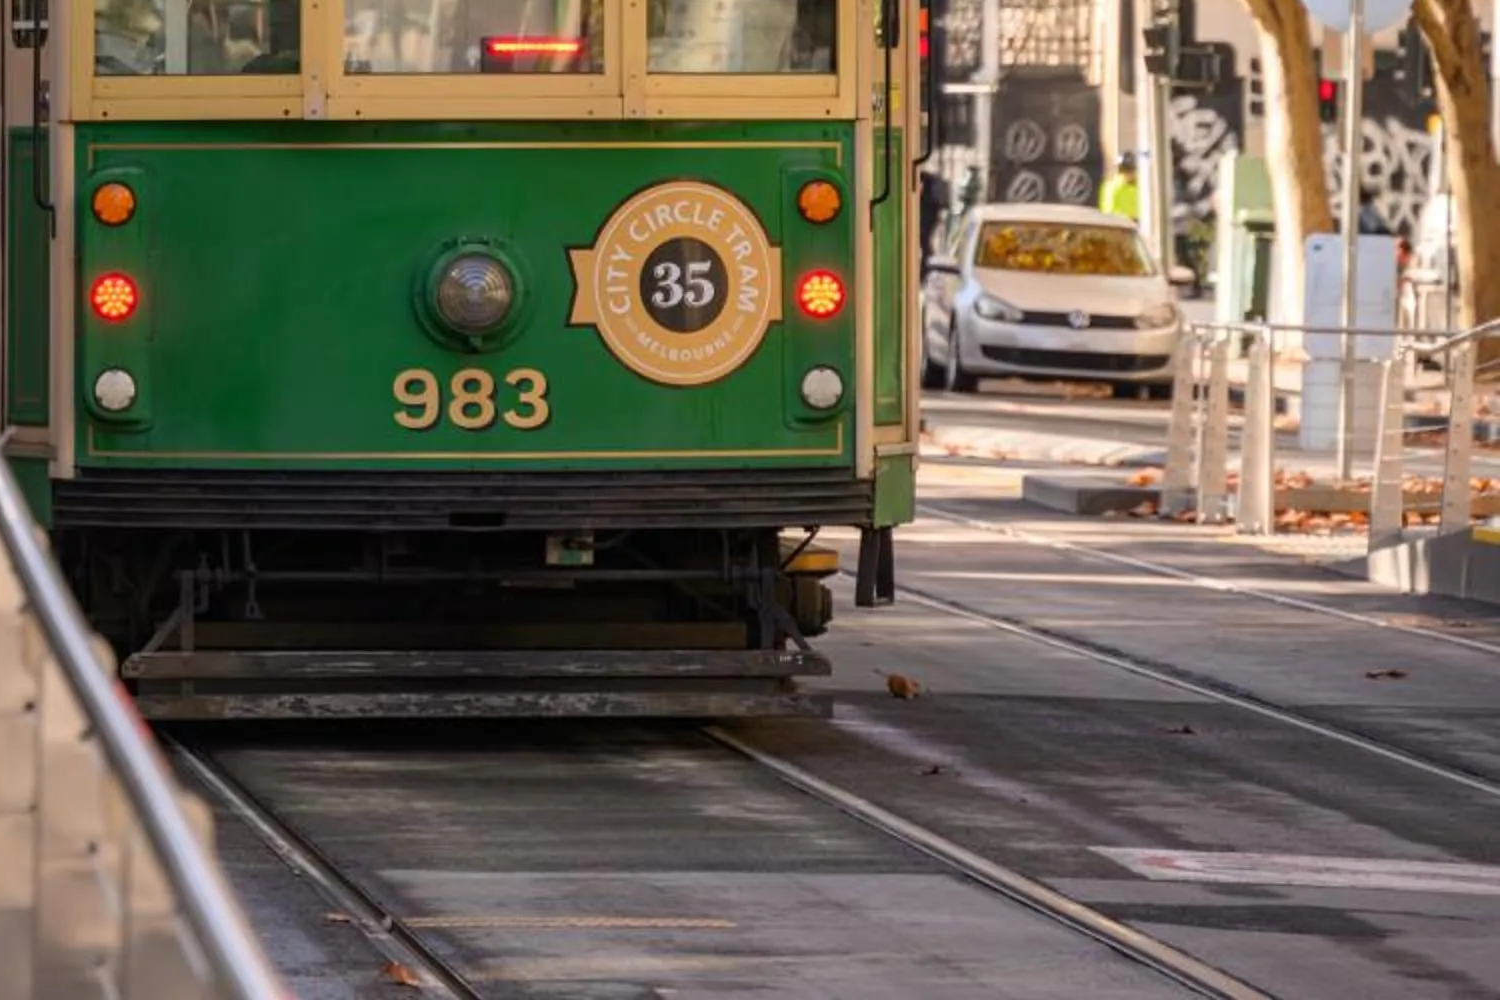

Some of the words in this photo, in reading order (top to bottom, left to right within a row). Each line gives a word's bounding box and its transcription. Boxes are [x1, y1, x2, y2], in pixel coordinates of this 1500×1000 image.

[606, 244, 634, 315] CITY
[629, 200, 725, 243] CIRCLE
[723, 222, 760, 313] TRAM
[651, 259, 715, 309] 35
[635, 331, 734, 362] MELBOURNE
[392, 367, 550, 430] 983
